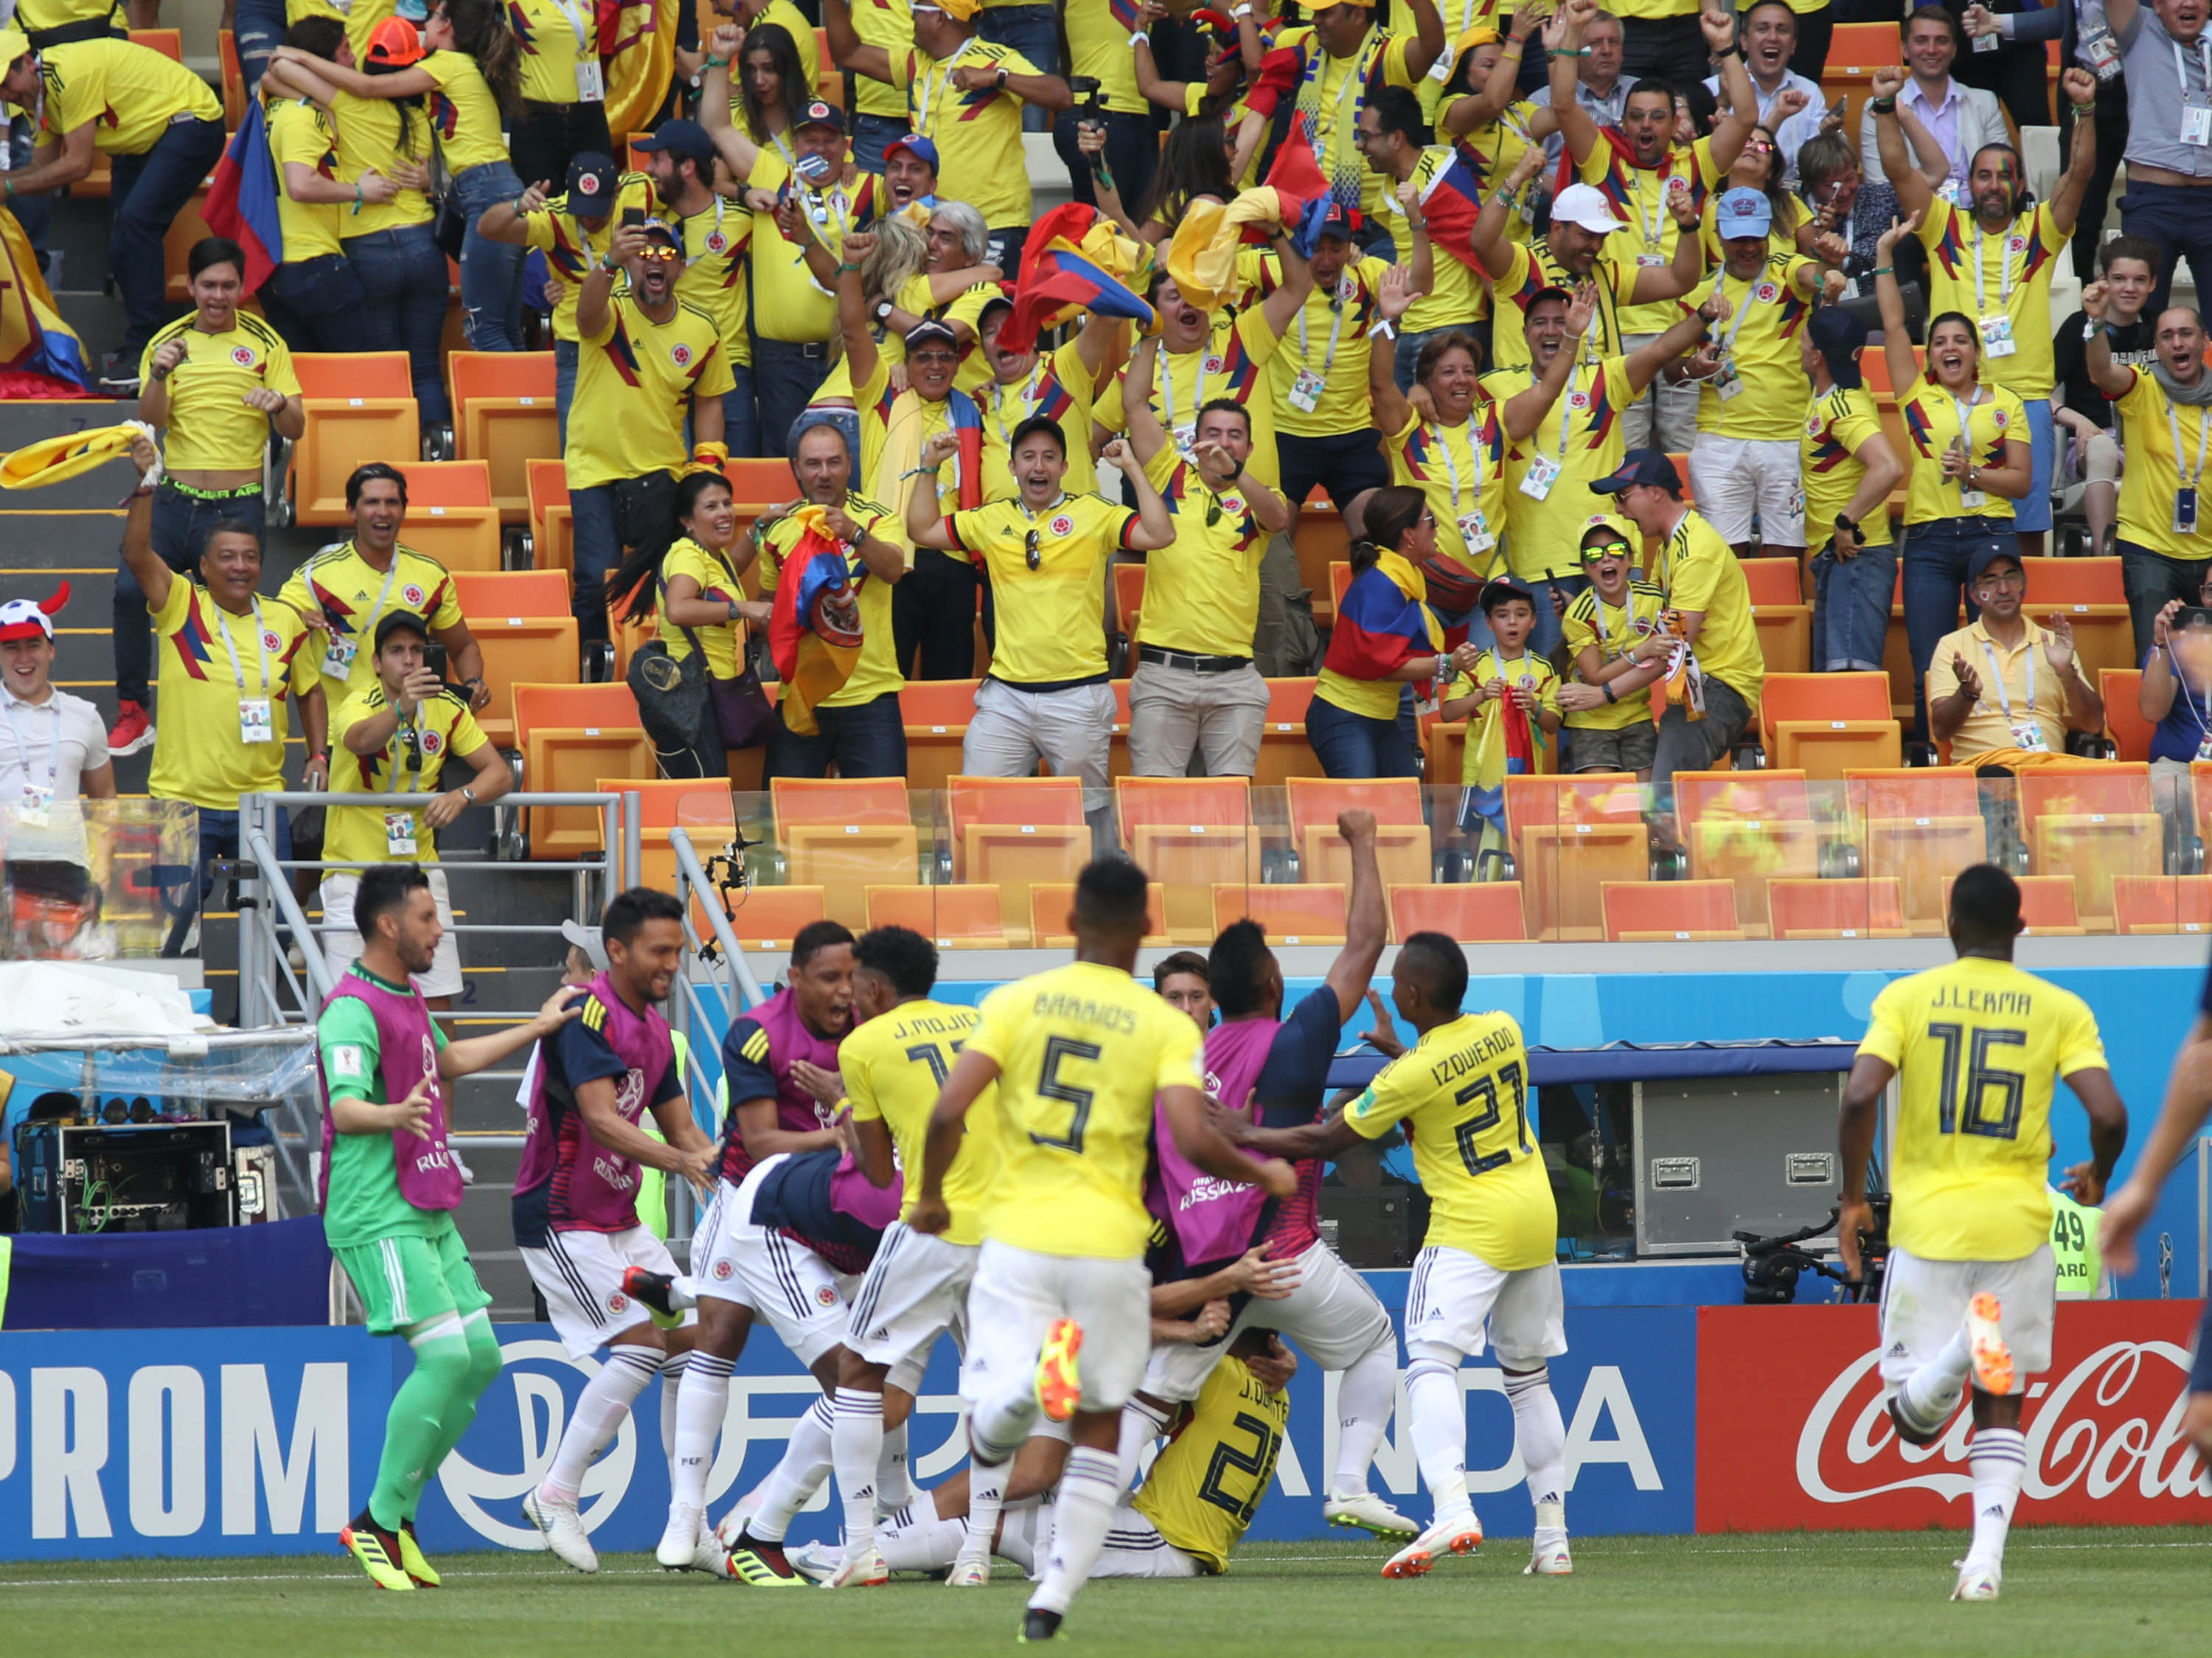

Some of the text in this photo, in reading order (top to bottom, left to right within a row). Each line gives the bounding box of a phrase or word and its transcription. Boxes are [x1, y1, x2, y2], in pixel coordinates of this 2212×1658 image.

[1431, 1027, 1515, 1086] IZQUIERDO
[1932, 985, 2031, 1016] J.LERMA
[1029, 1036, 1102, 1154] 5
[1454, 1060, 1534, 1176] 21
[1928, 1022, 2027, 1140] 16
[2054, 1210, 2085, 1252] 49
[0, 1362, 349, 1539] ROM
